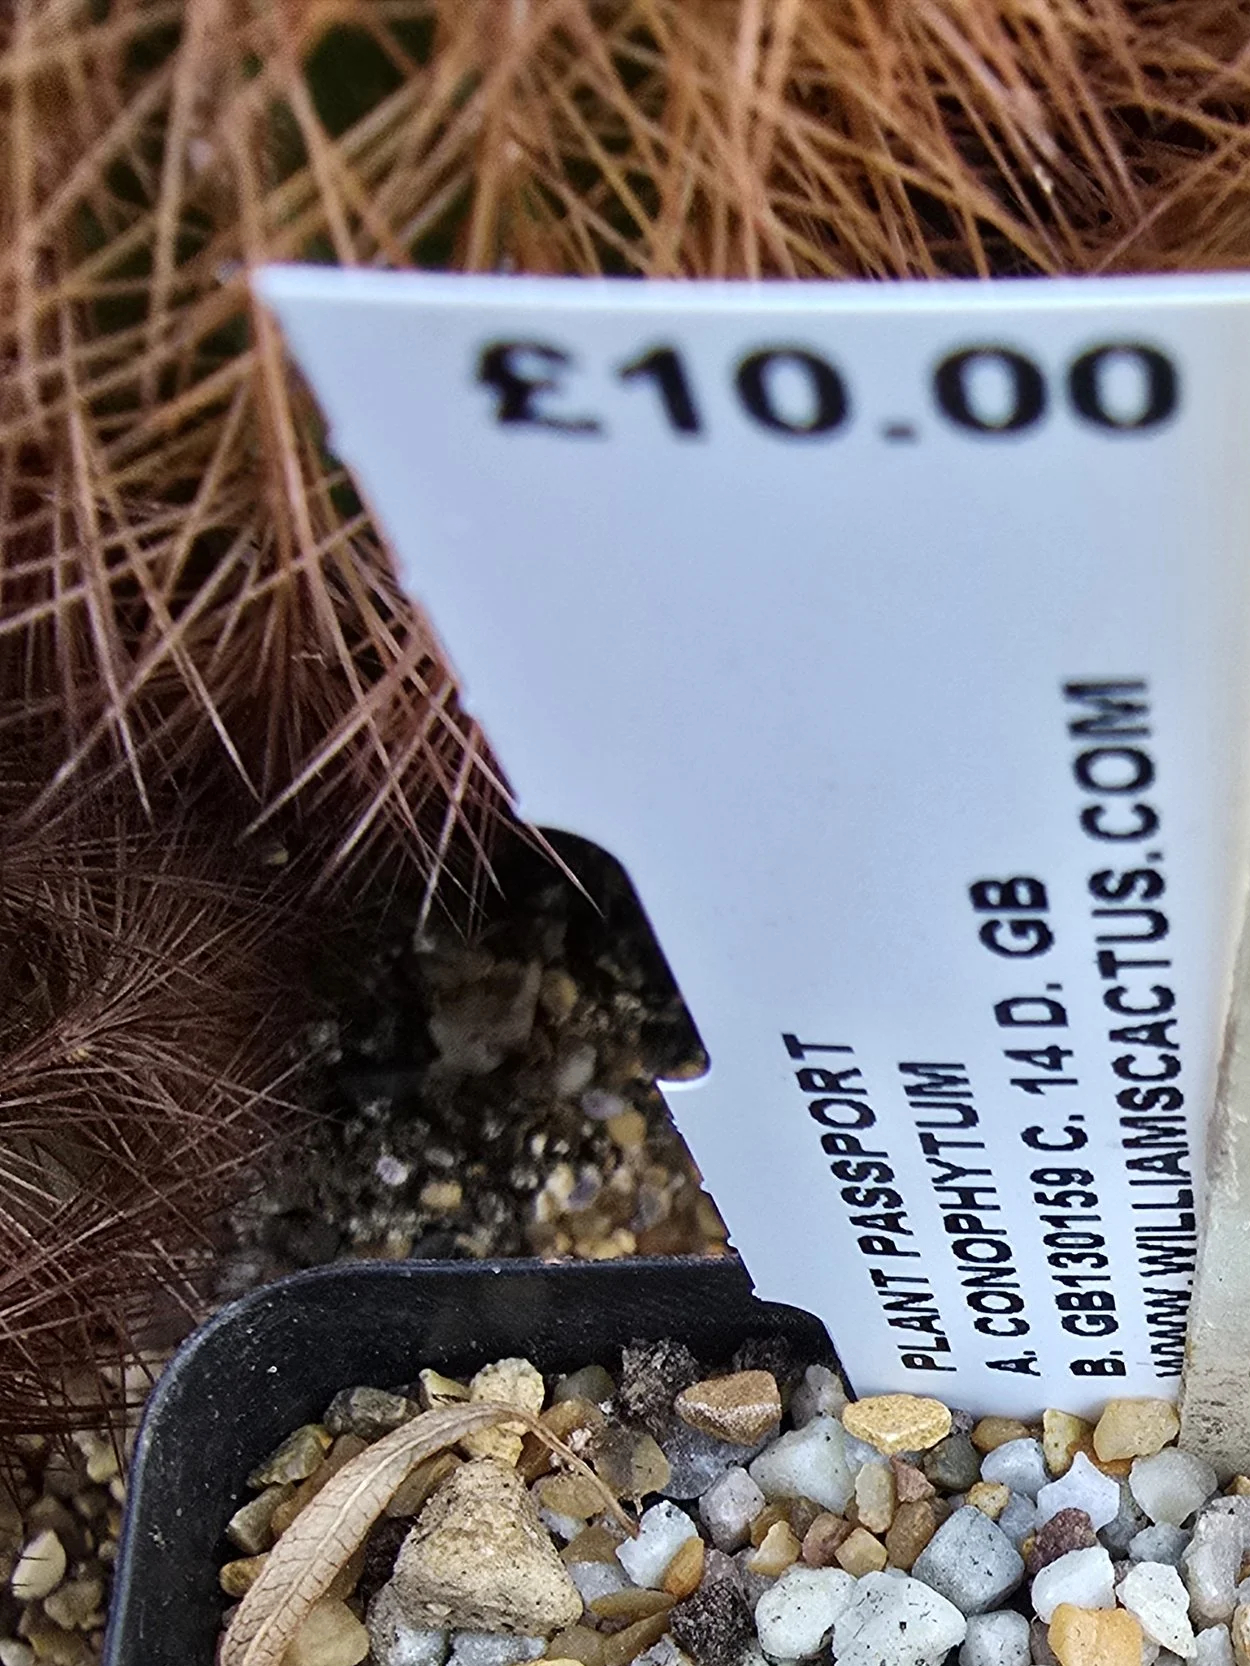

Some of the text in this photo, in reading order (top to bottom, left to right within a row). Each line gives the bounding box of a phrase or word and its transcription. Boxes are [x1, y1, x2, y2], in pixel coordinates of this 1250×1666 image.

[472, 338, 1184, 440] £10.00
[967, 875, 1129, 1379] B. GB130159 C. 14 D. GB
[1061, 678, 1200, 1379] WWW.WILLIAMSCACTUS.COM
[780, 1030, 960, 1375] PLANT PASSPORT
[896, 1060, 1043, 1379] A. CONOPHYTUM
